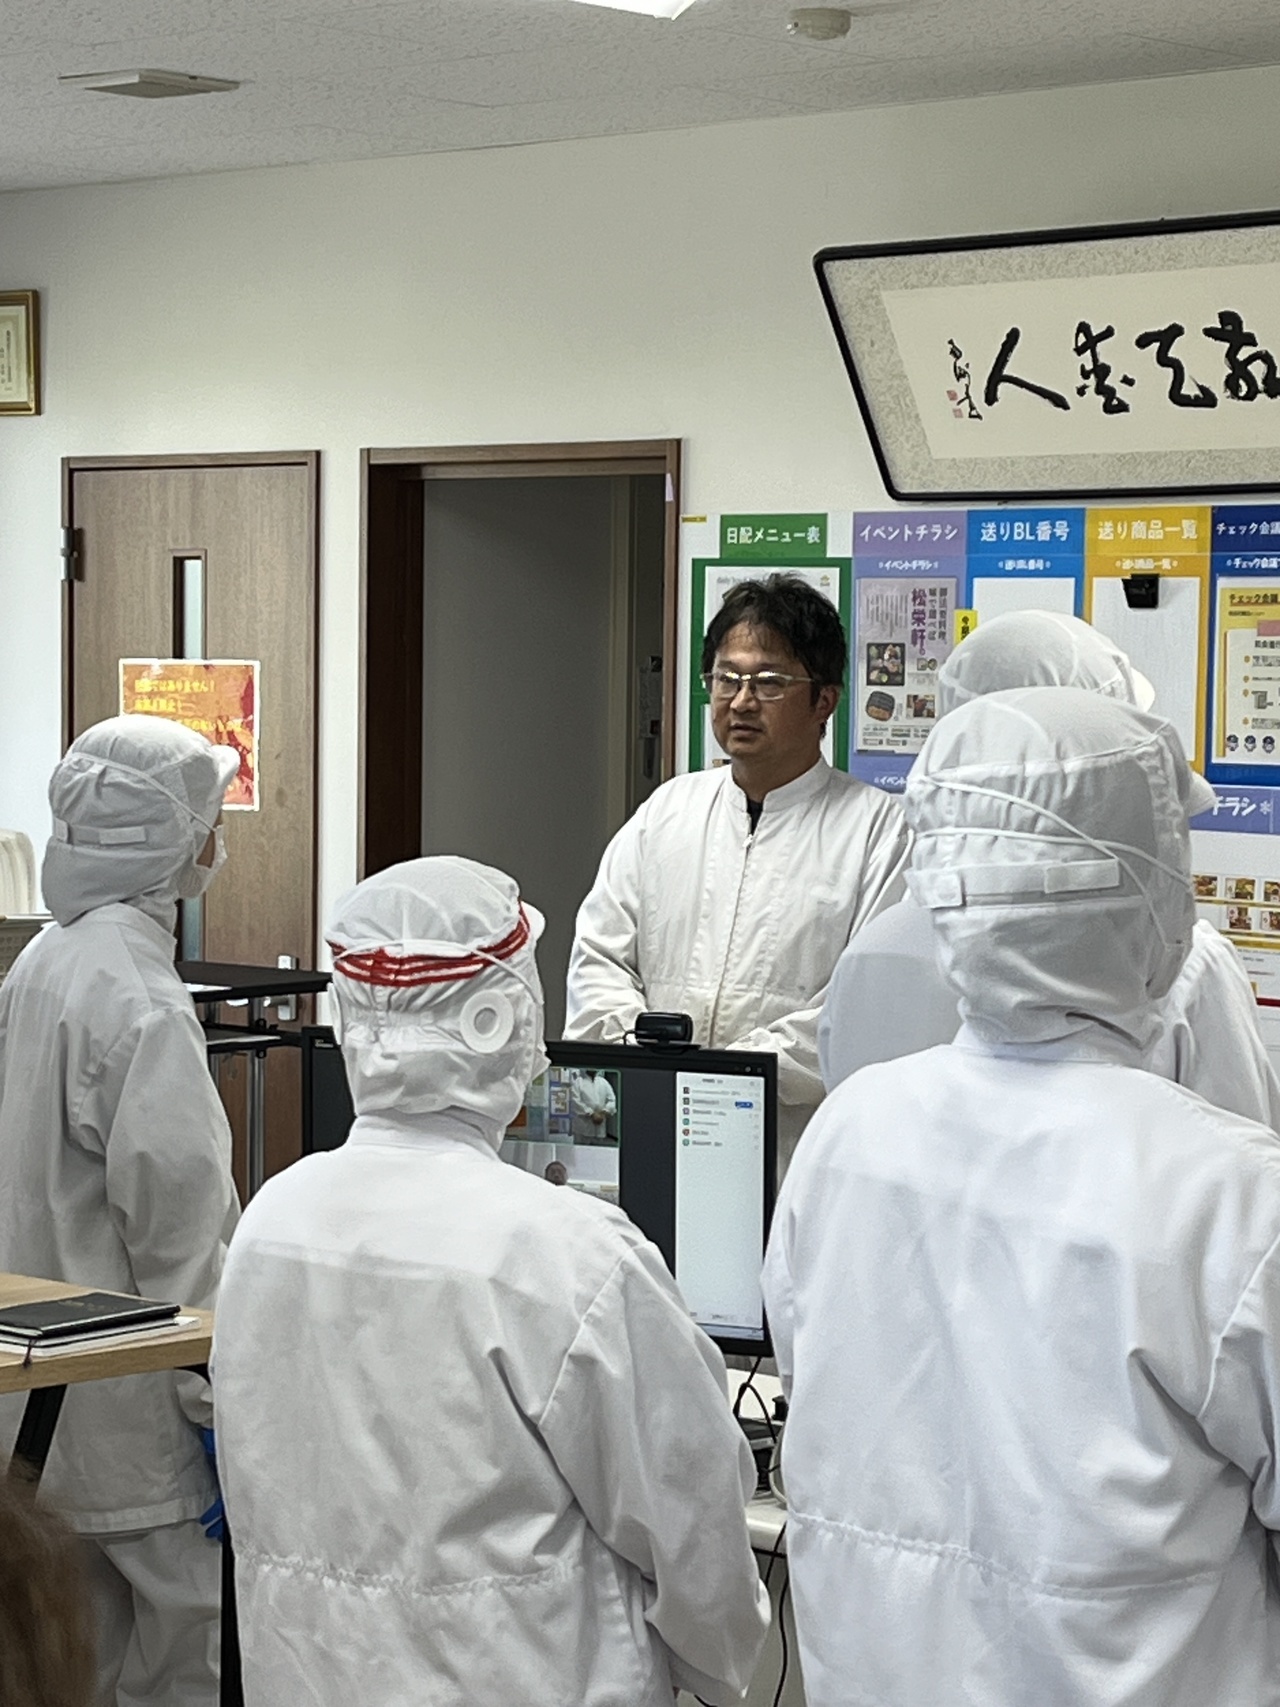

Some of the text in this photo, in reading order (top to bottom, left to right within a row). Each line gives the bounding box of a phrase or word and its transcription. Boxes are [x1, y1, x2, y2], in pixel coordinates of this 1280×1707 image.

[726, 525, 820, 544] 日配メニュー表
[859, 524, 958, 541] イベントチラシ
[980, 520, 1070, 541] 送りBL番号
[1098, 519, 1198, 540] 送り商品一覧
